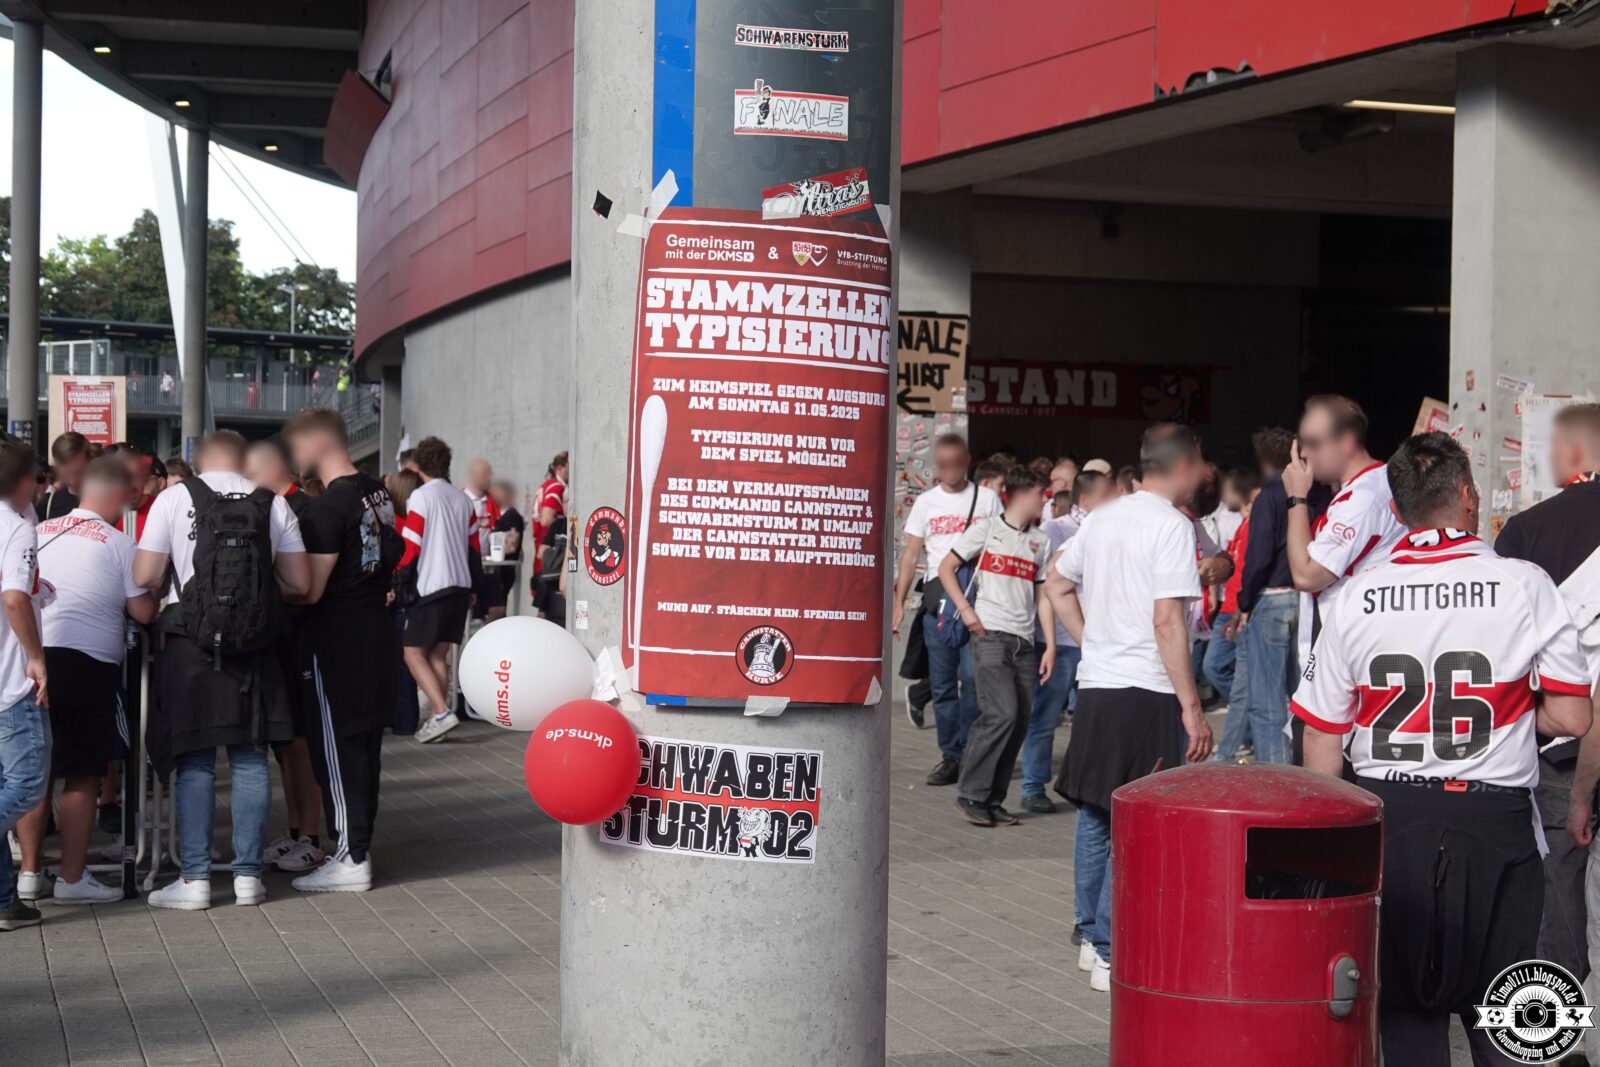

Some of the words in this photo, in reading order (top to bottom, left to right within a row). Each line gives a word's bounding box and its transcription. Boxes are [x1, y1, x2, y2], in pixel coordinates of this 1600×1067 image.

[737, 27, 847, 49] SCHWABENSTURM
[665, 249, 684, 259] mit
[687, 250, 705, 260] der
[666, 234, 755, 250] Gemeinsam
[768, 246, 779, 259] &
[837, 250, 888, 265] VfB-STIFTUNG
[646, 277, 891, 327] STAMMZELLEN
[645, 312, 890, 364] TYPISIERUNG
[898, 319, 966, 358] NALE
[653, 378, 685, 392] ZUM
[689, 379, 773, 397] HEIMSPIEL
[777, 385, 823, 400] GEGEN
[827, 388, 886, 407] AUGSBURG
[968, 365, 1117, 408] STAND
[688, 396, 714, 410] AM
[718, 397, 790, 415] SONNTAG
[794, 402, 860, 420] 11.05.2025
[690, 429, 793, 447] TYPISIERUNG
[796, 436, 827, 450] NUR
[830, 438, 856, 452] VOR
[701, 446, 735, 461] DEM
[740, 448, 784, 464] SPIEL
[787, 450, 847, 468] MÖGLICH
[667, 477, 693, 491] BEI
[697, 480, 728, 494] DEN
[733, 480, 869, 502] VERKAUFSSTÄNDEN
[660, 493, 688, 507] DES
[692, 495, 781, 513] COMMANDO
[784, 500, 863, 518] CANNSTATT
[865, 506, 873, 518] &
[659, 510, 798, 531] SCHWABENSTURM
[801, 517, 820, 532] IM
[823, 519, 873, 535] UMLAUF
[672, 527, 702, 542] DER
[707, 529, 816, 547] CANNSTATTER
[820, 535, 862, 550] KURVE
[652, 543, 700, 558] SOWIE
[704, 545, 736, 560] VOR
[740, 547, 771, 562] DER
[775, 549, 876, 567] HAUPTTRIBÜNE
[1363, 581, 1501, 615] STUTTGART
[657, 601, 689, 613] MUND
[690, 603, 714, 614] AUF.
[717, 604, 772, 617] STÄBCHEN
[774, 607, 801, 619] REIN.
[804, 609, 845, 620] SPENDER
[847, 611, 867, 621] SEIN!
[740, 626, 792, 652] CANNSTATTER
[746, 671, 784, 685] KURVE
[494, 659, 513, 728] dkms.de
[1369, 650, 1496, 763] 26
[545, 727, 613, 749] dkms.de
[636, 738, 820, 802] CHWABEN
[761, 809, 815, 860] 02
